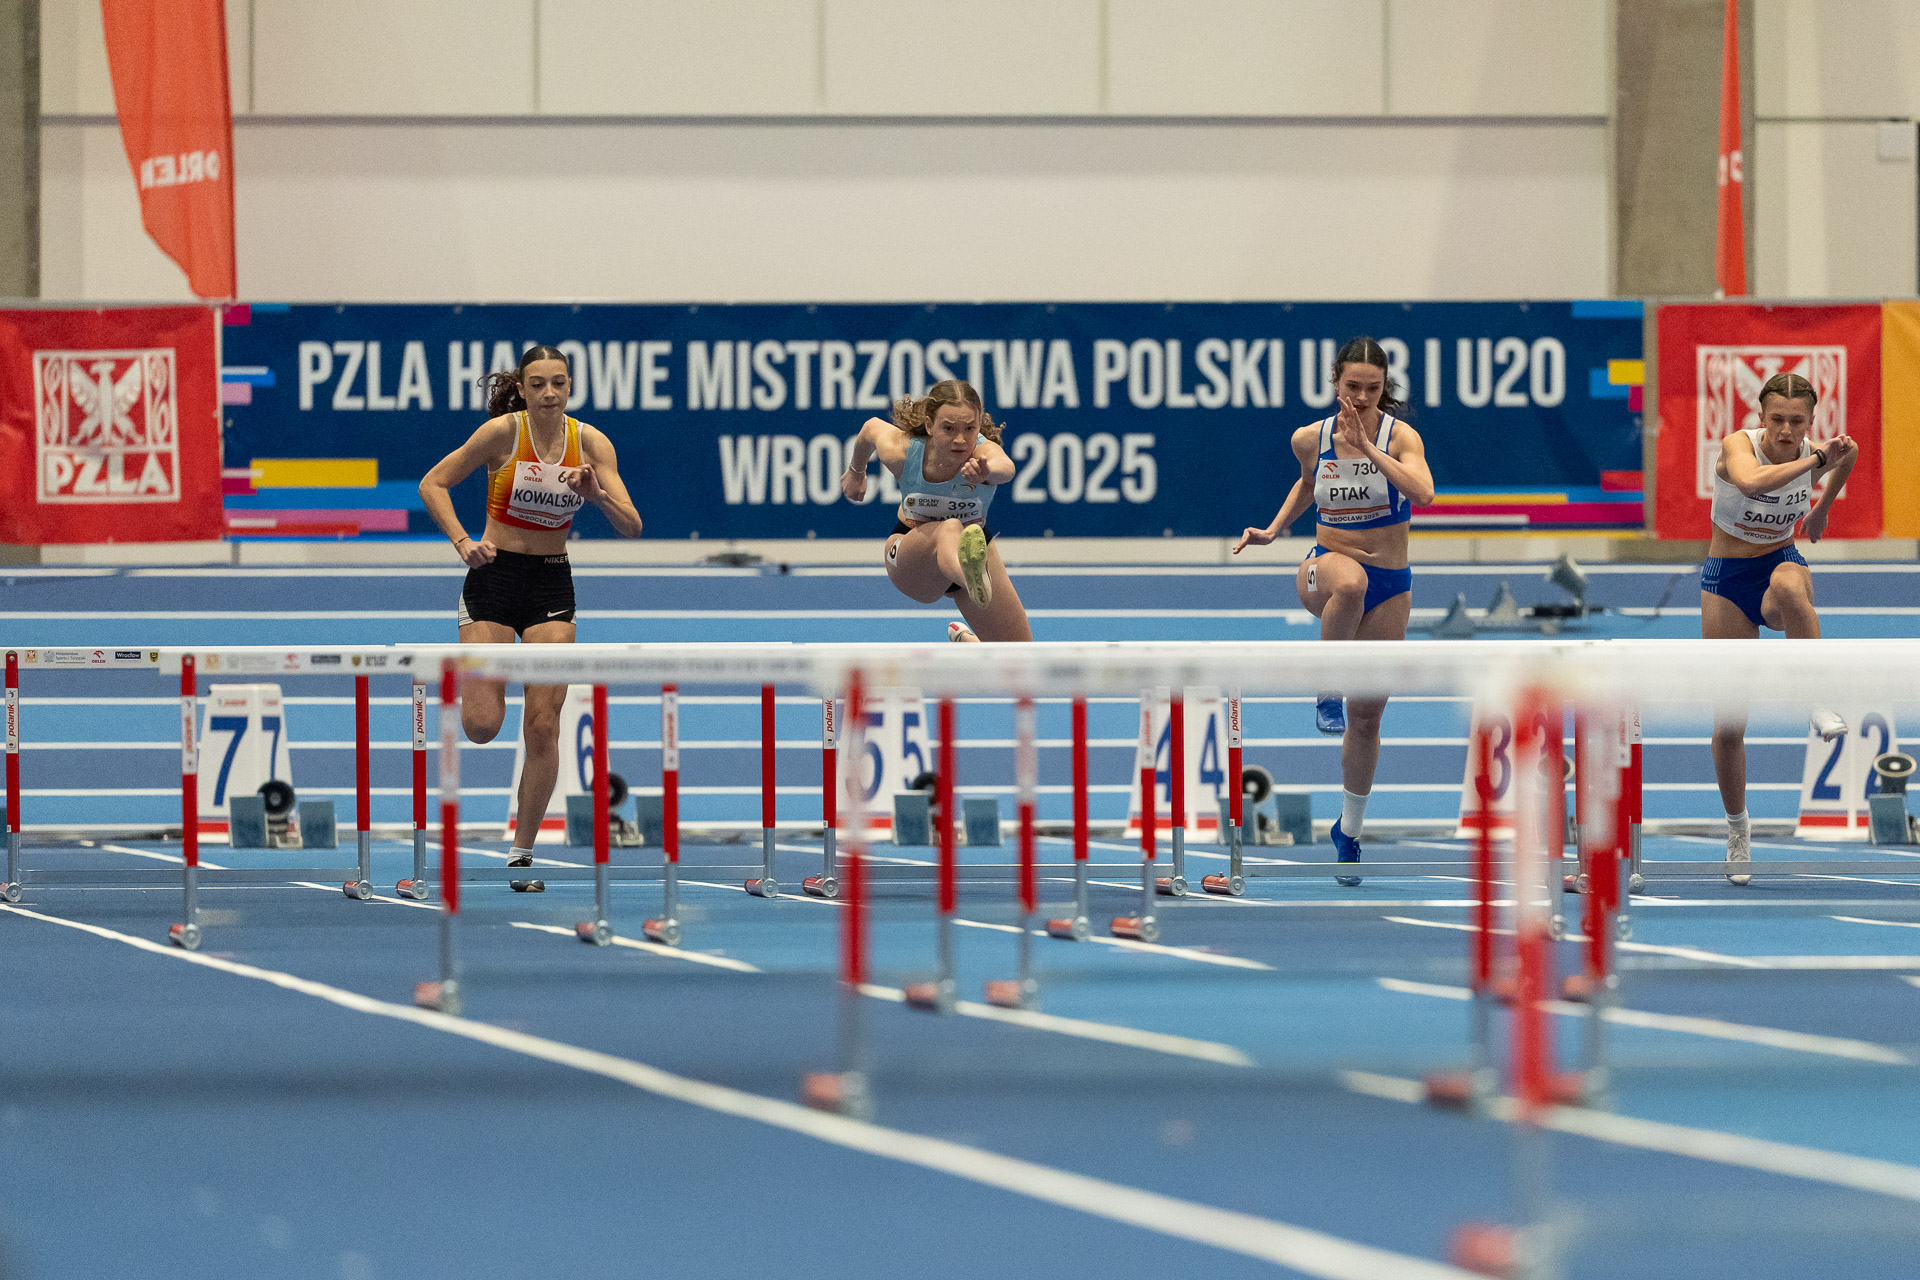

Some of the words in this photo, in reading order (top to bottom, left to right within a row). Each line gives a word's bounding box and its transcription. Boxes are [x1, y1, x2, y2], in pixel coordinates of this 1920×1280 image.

[299, 341, 433, 411] PZLA
[448, 340, 672, 411] HAOWE
[687, 339, 1079, 410] MISTRZOSTWA
[1093, 338, 1285, 409] POLSKI
[1299, 337, 1410, 409] U8
[1424, 337, 1442, 408] I
[1456, 336, 1566, 409] U20
[47, 452, 171, 493] PZLA
[1012, 432, 1158, 504] 2025
[1352, 462, 1379, 476] 730
[513, 488, 581, 508] KOWALSKA
[948, 501, 976, 511] 399
[1329, 486, 1370, 501] PTAK
[1785, 490, 1807, 506] 215
[1743, 510, 1804, 525] SADURA
[544, 555, 565, 564] NIKE
[7, 703, 16, 737] polanik
[415, 700, 424, 734] polanik
[825, 699, 834, 733] polanik
[1230, 698, 1239, 732] polanik
[210, 716, 248, 806] 7
[262, 716, 281, 781] 7
[903, 712, 925, 790] 5
[1199, 712, 1225, 797] 4
[1861, 712, 1889, 800] 2
